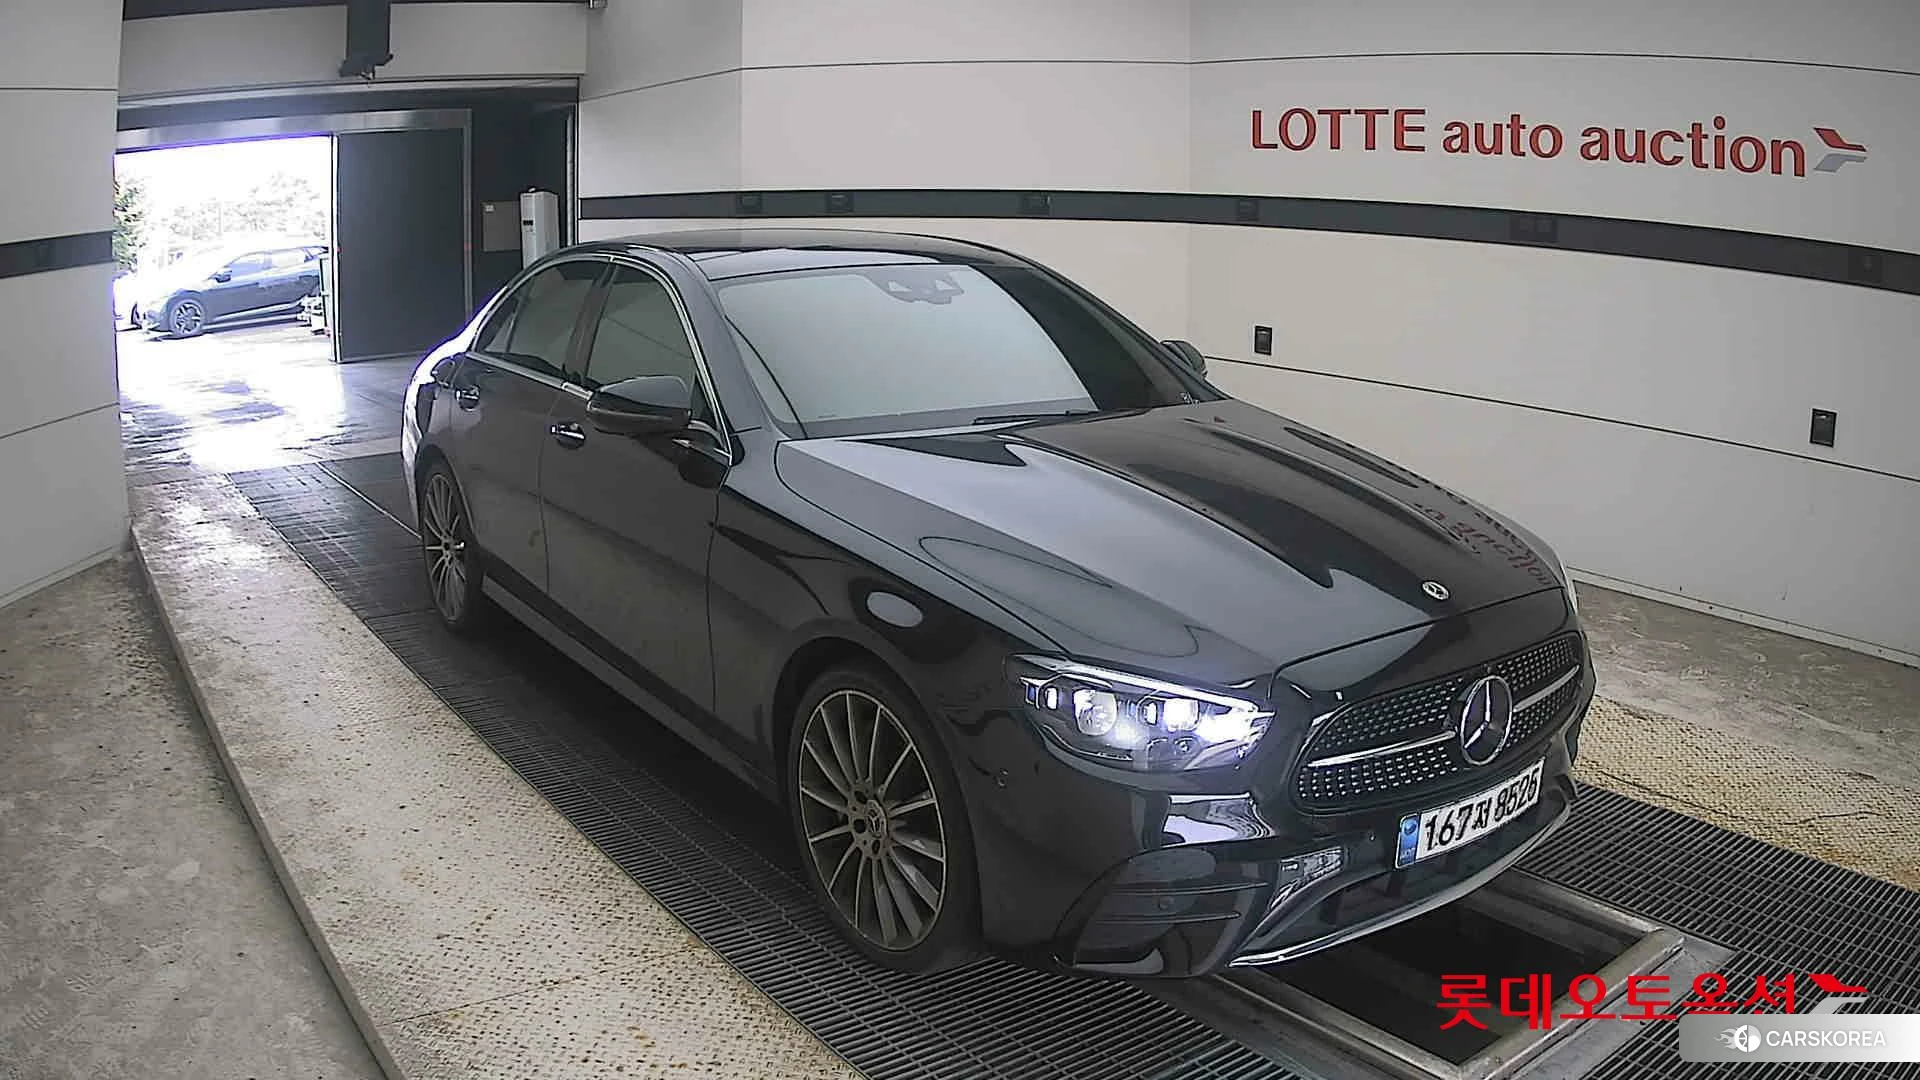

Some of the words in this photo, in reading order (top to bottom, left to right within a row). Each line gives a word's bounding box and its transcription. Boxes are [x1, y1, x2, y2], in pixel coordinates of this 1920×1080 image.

[1250, 107, 1426, 152] LOTTE
[1442, 114, 1565, 157] auto
[1579, 116, 1807, 177] auction
